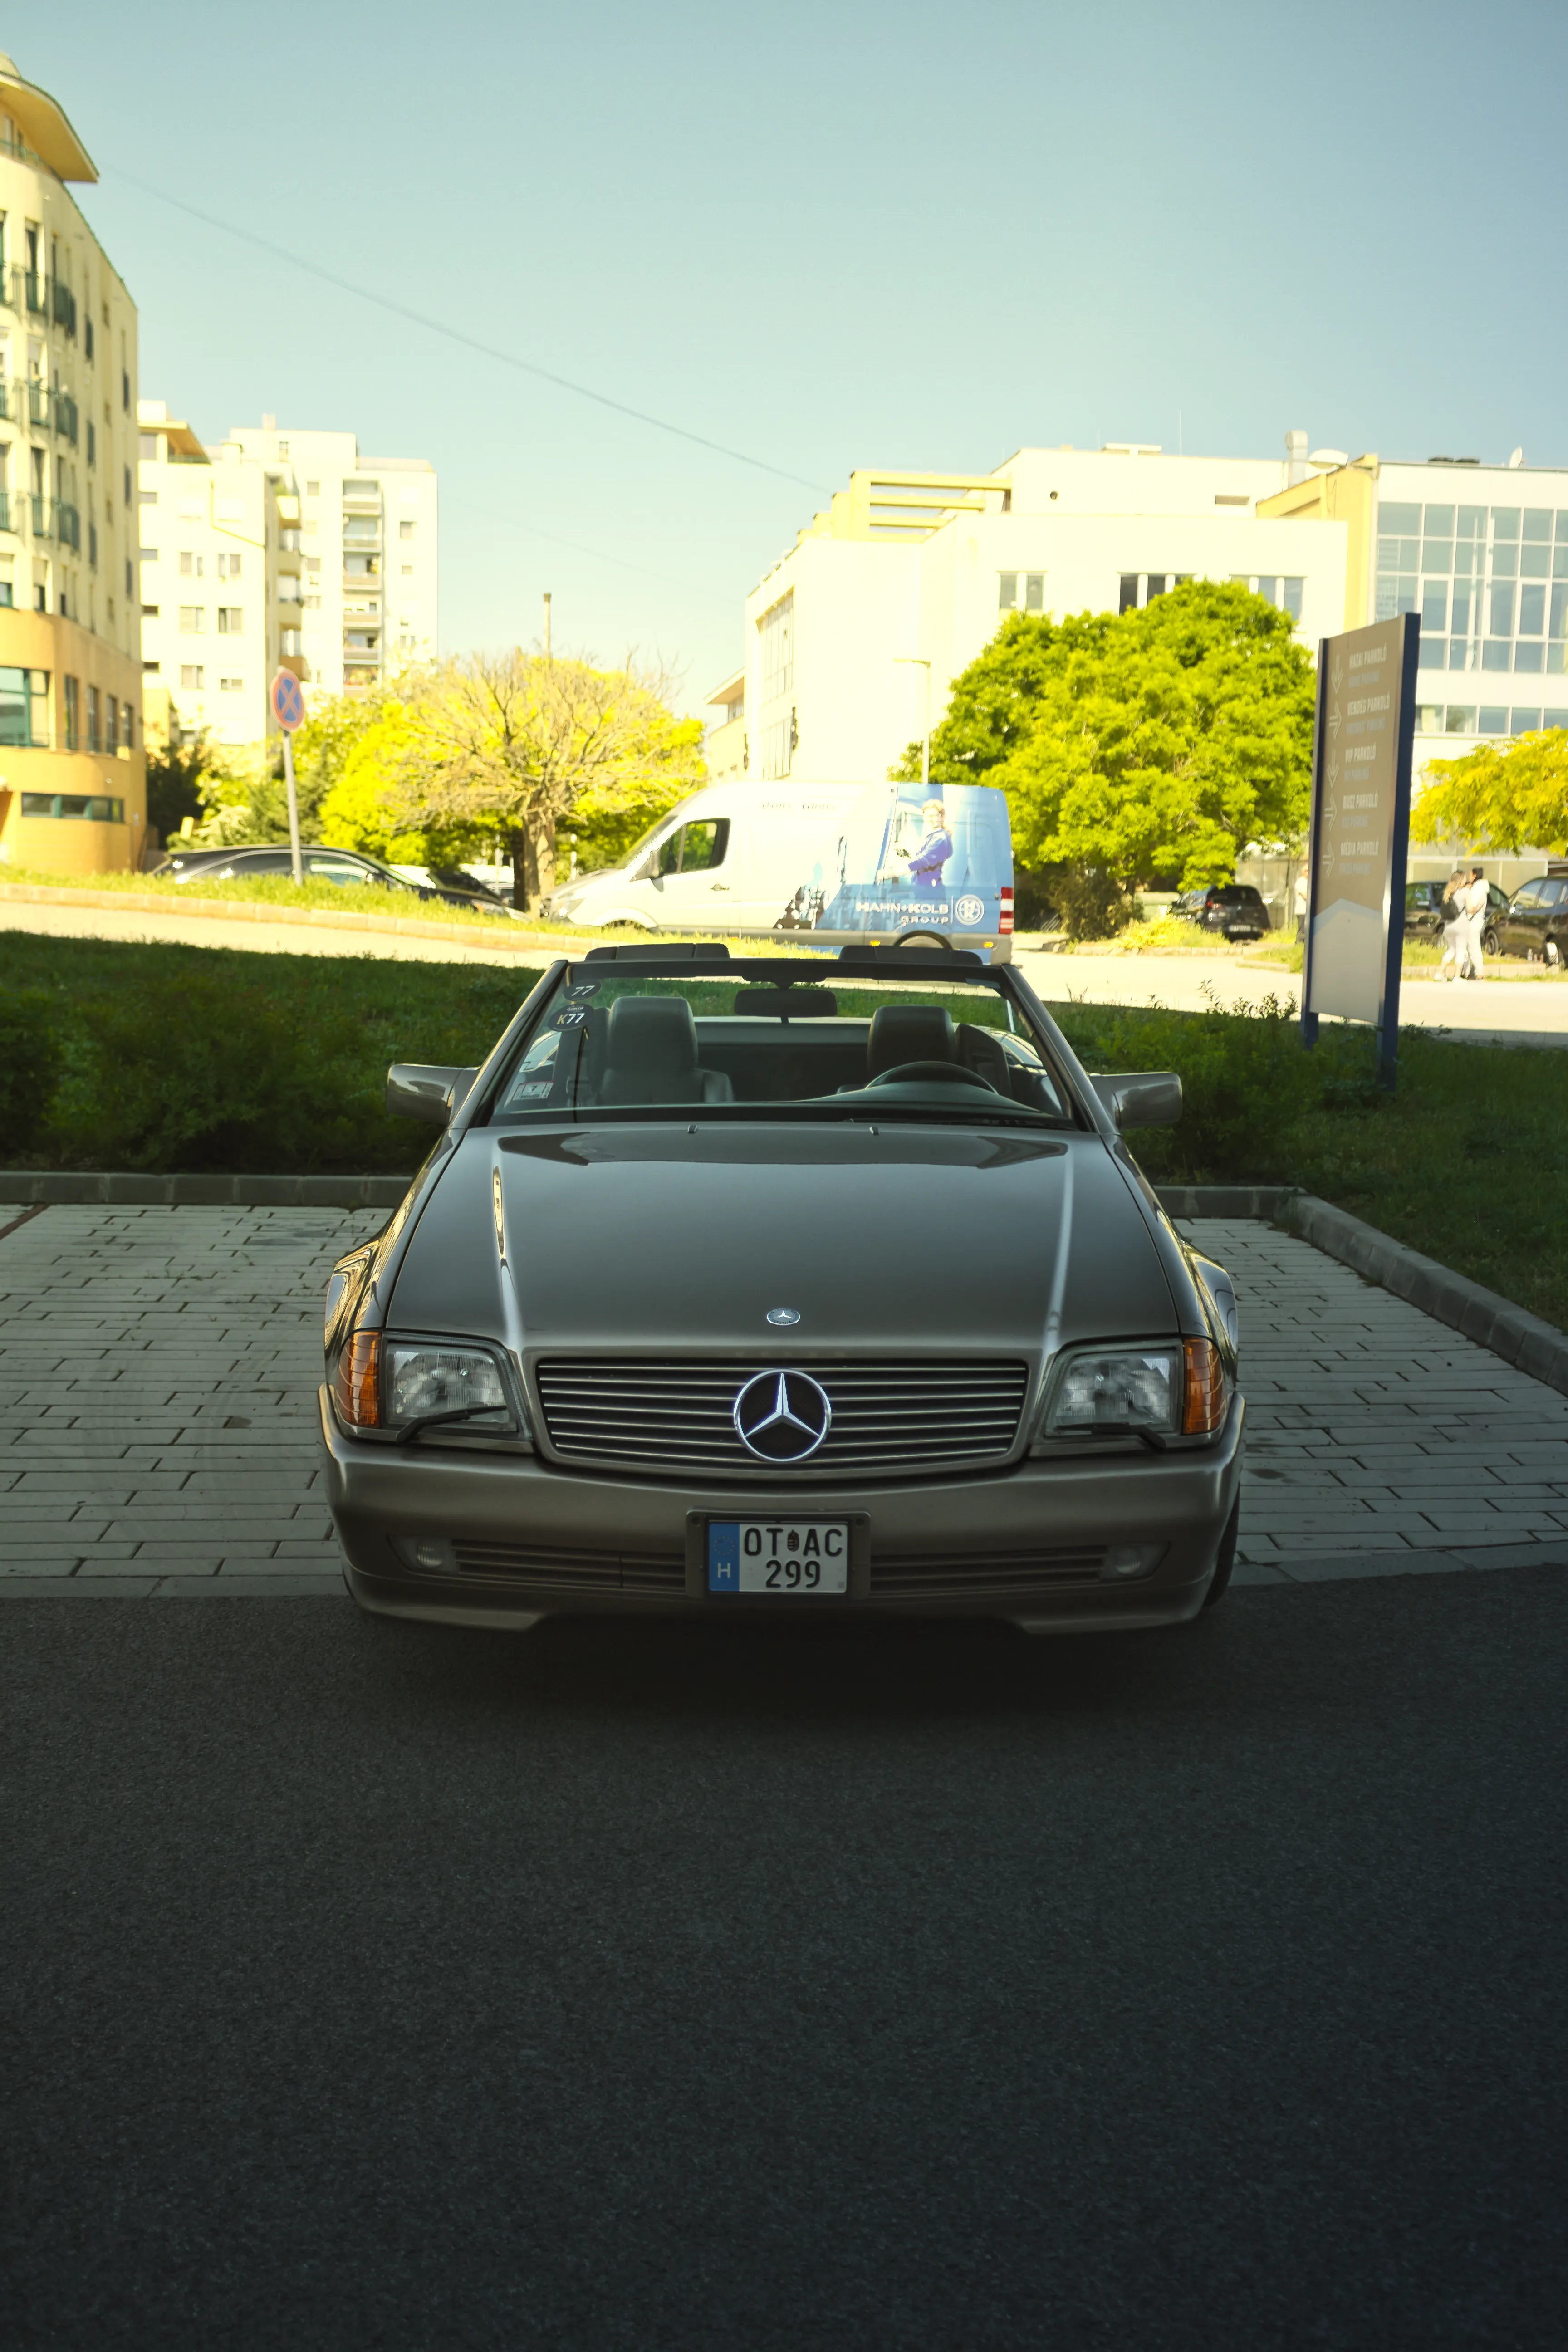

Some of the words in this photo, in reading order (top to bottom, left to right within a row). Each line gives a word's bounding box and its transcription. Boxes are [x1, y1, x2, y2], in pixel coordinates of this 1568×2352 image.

[1363, 642, 1387, 666] PARKOLÓ
[1367, 691, 1390, 713] PARKOLÓ
[1354, 742, 1376, 762] PARKOLÓ
[1356, 789, 1378, 808] PARKOLÓ
[1356, 838, 1379, 856] PARKOLÓ
[855, 902, 949, 914] HAHN+KOLB
[556, 1013, 585, 1025] K77
[744, 1528, 784, 1557] OT
[803, 1528, 843, 1557] AC
[717, 1562, 731, 1578] H
[766, 1560, 821, 1588] 299
